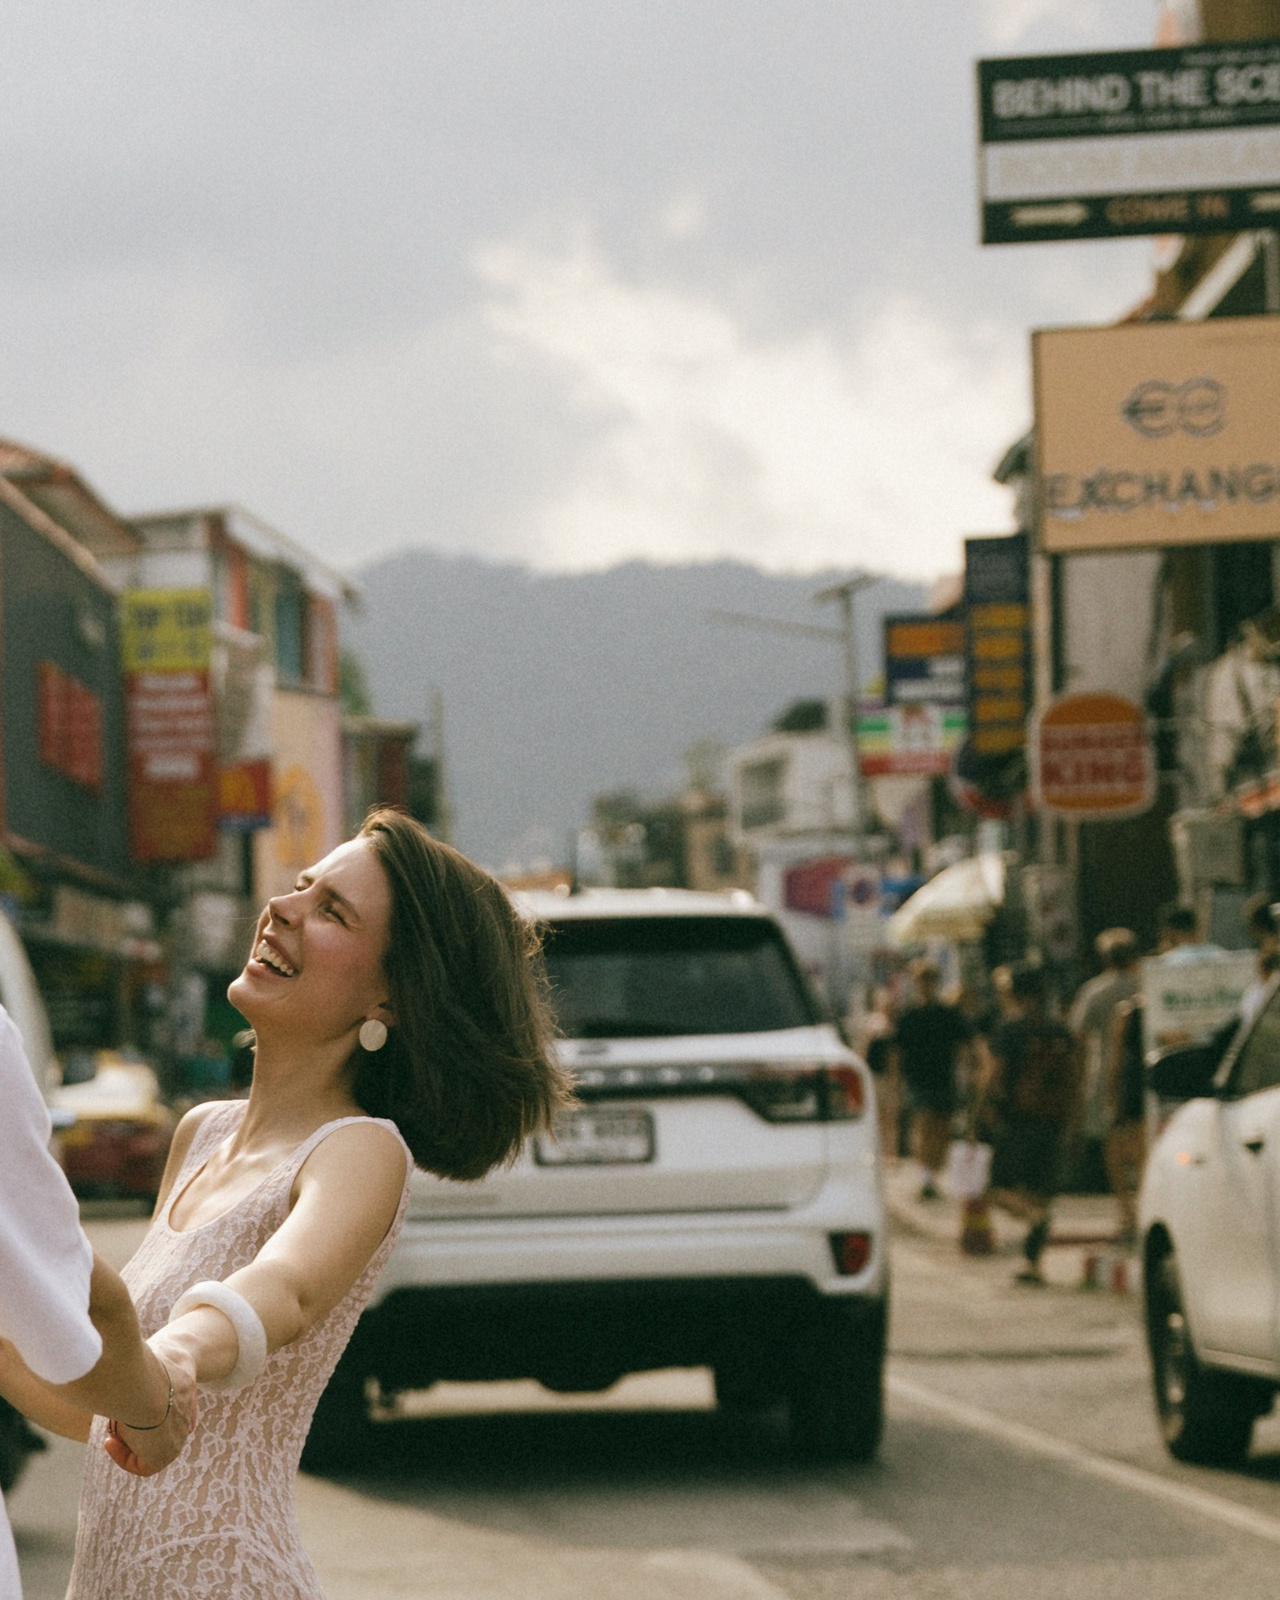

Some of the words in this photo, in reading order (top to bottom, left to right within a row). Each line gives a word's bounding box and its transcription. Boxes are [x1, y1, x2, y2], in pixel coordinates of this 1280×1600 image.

[992, 74, 1132, 120] BEHIND
[1134, 67, 1211, 108] THE
[1044, 463, 1280, 511] EXCHANG
